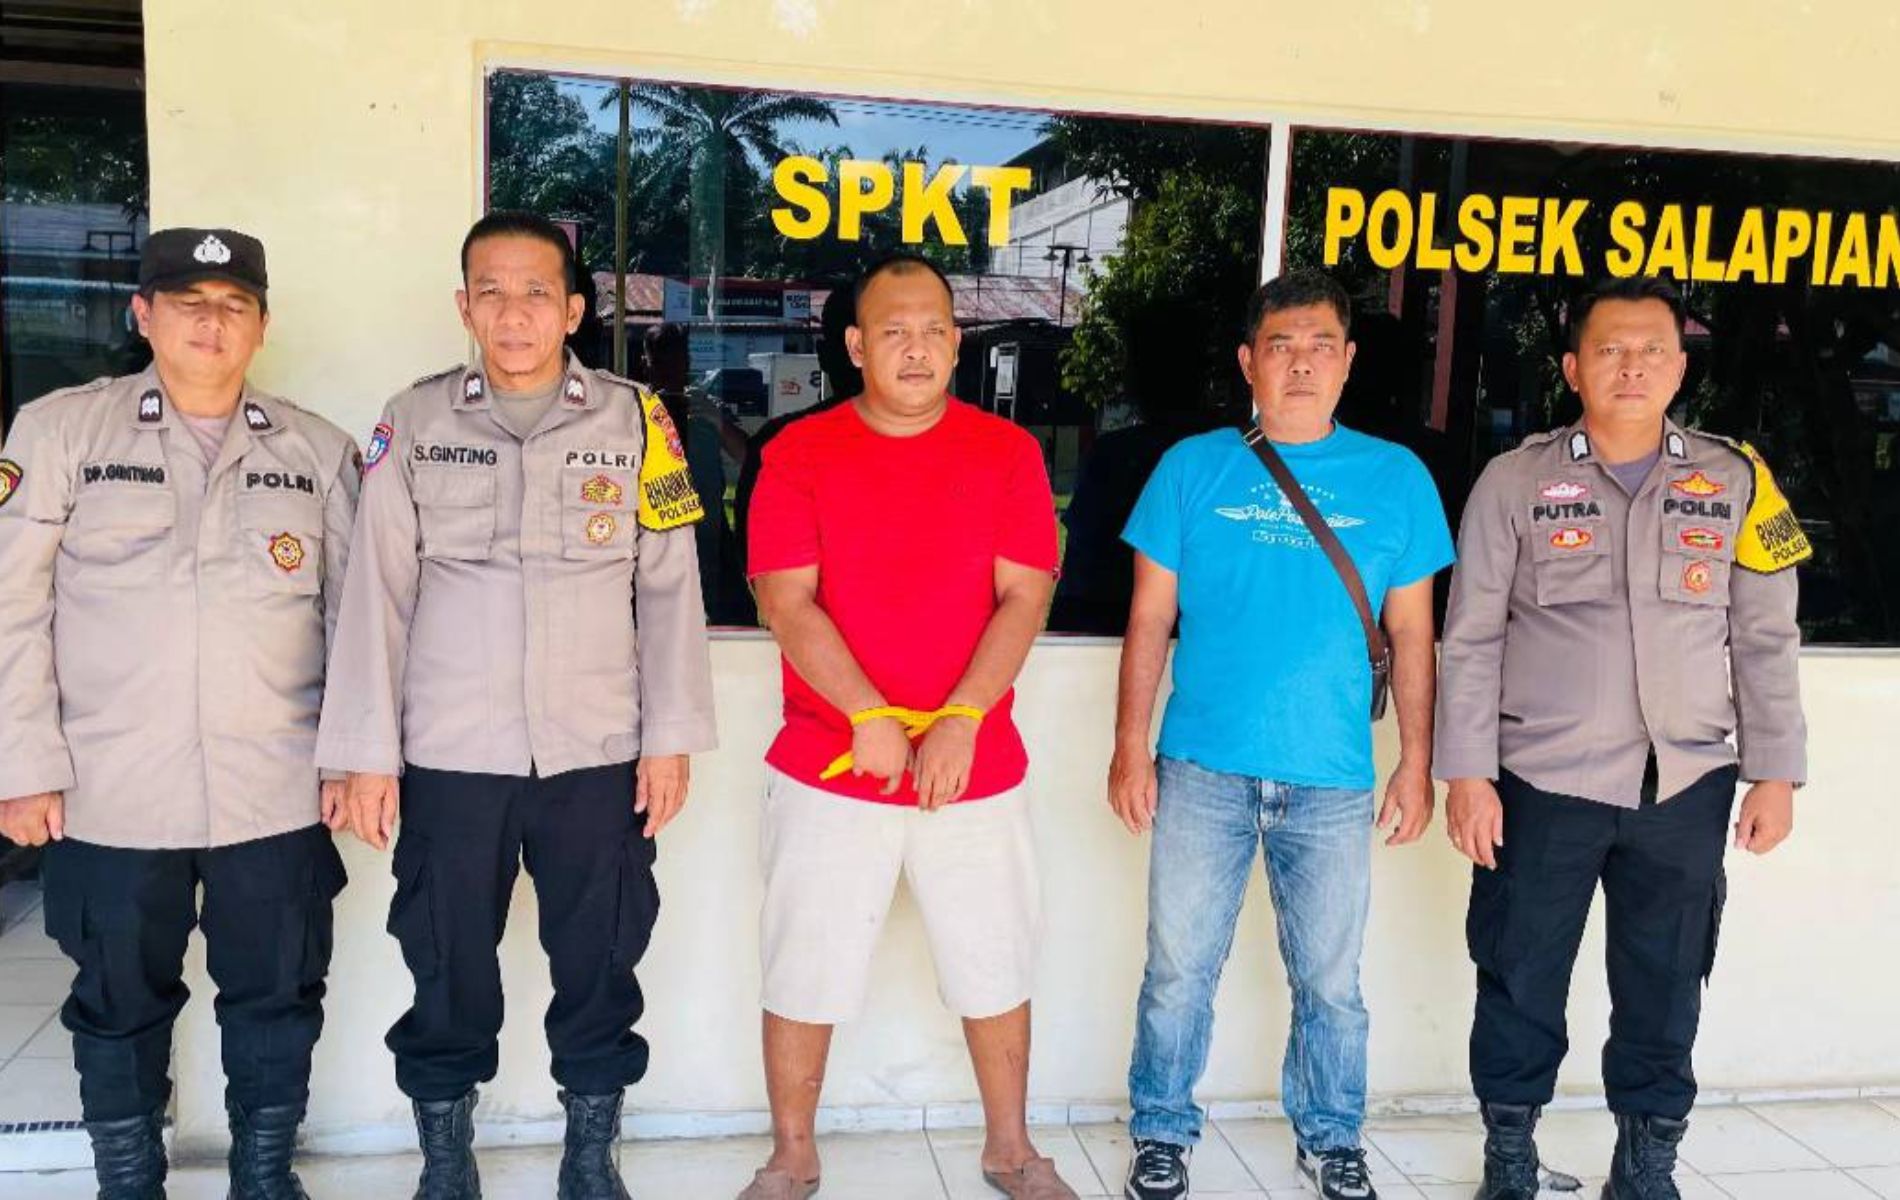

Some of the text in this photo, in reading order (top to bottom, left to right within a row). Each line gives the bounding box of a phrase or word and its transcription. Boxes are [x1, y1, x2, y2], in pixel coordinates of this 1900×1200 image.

[772, 156, 1031, 247] SPKT
[1324, 187, 1900, 288] POLSEK SALAPIAN
[413, 444, 498, 467] S.GINTING
[565, 451, 636, 469] POLRI
[246, 472, 315, 495] POLRI
[1533, 501, 1601, 523] PUTRA
[1663, 498, 1731, 520] POLRI
